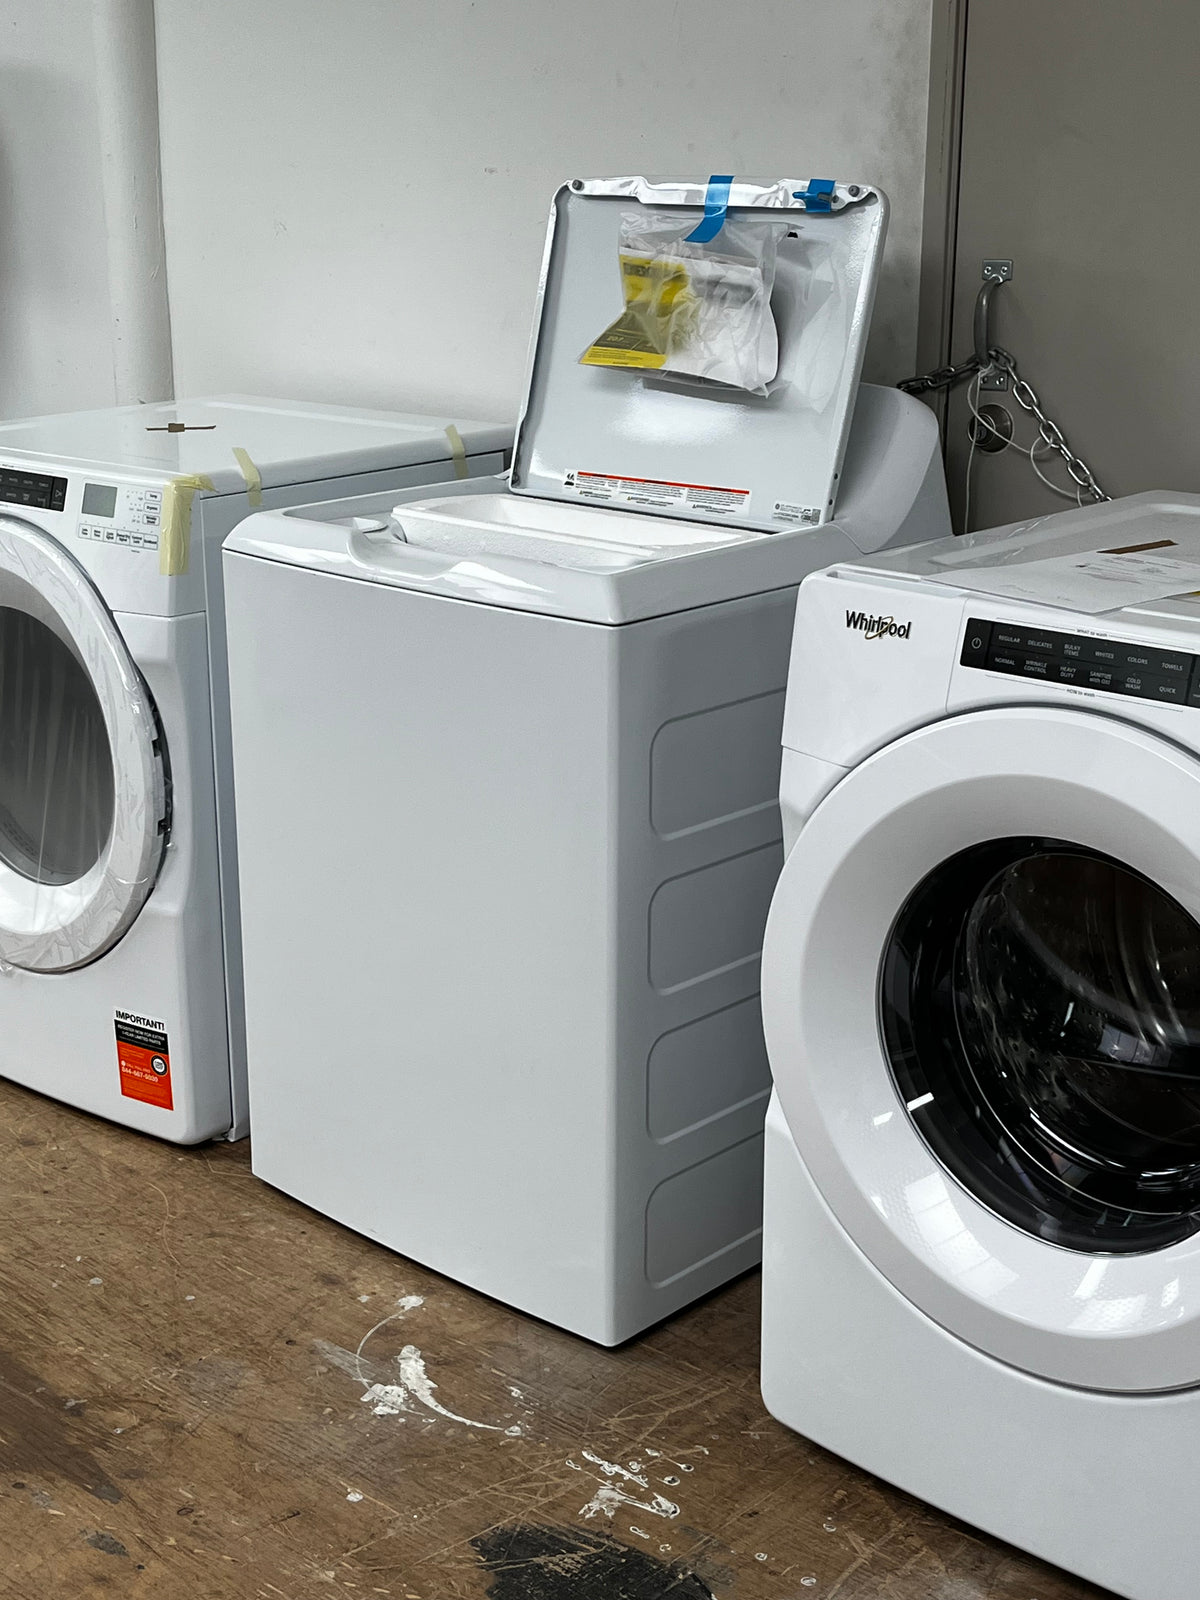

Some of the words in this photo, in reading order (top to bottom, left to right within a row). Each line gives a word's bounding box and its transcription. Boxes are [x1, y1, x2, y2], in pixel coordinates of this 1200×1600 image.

[846, 610, 912, 639] Whirlpool
[999, 635, 1020, 643] REGULAR
[1028, 640, 1052, 649] DELICATES
[1095, 651, 1114, 659] WHITES
[995, 657, 1015, 665] NORMAL
[1026, 660, 1047, 668] WRINKLE
[1024, 665, 1046, 674] CONTROL
[1162, 663, 1183, 671] TOWELS
[1159, 686, 1176, 694] QUICK
[116, 1010, 164, 1030] IMPORTANT!
